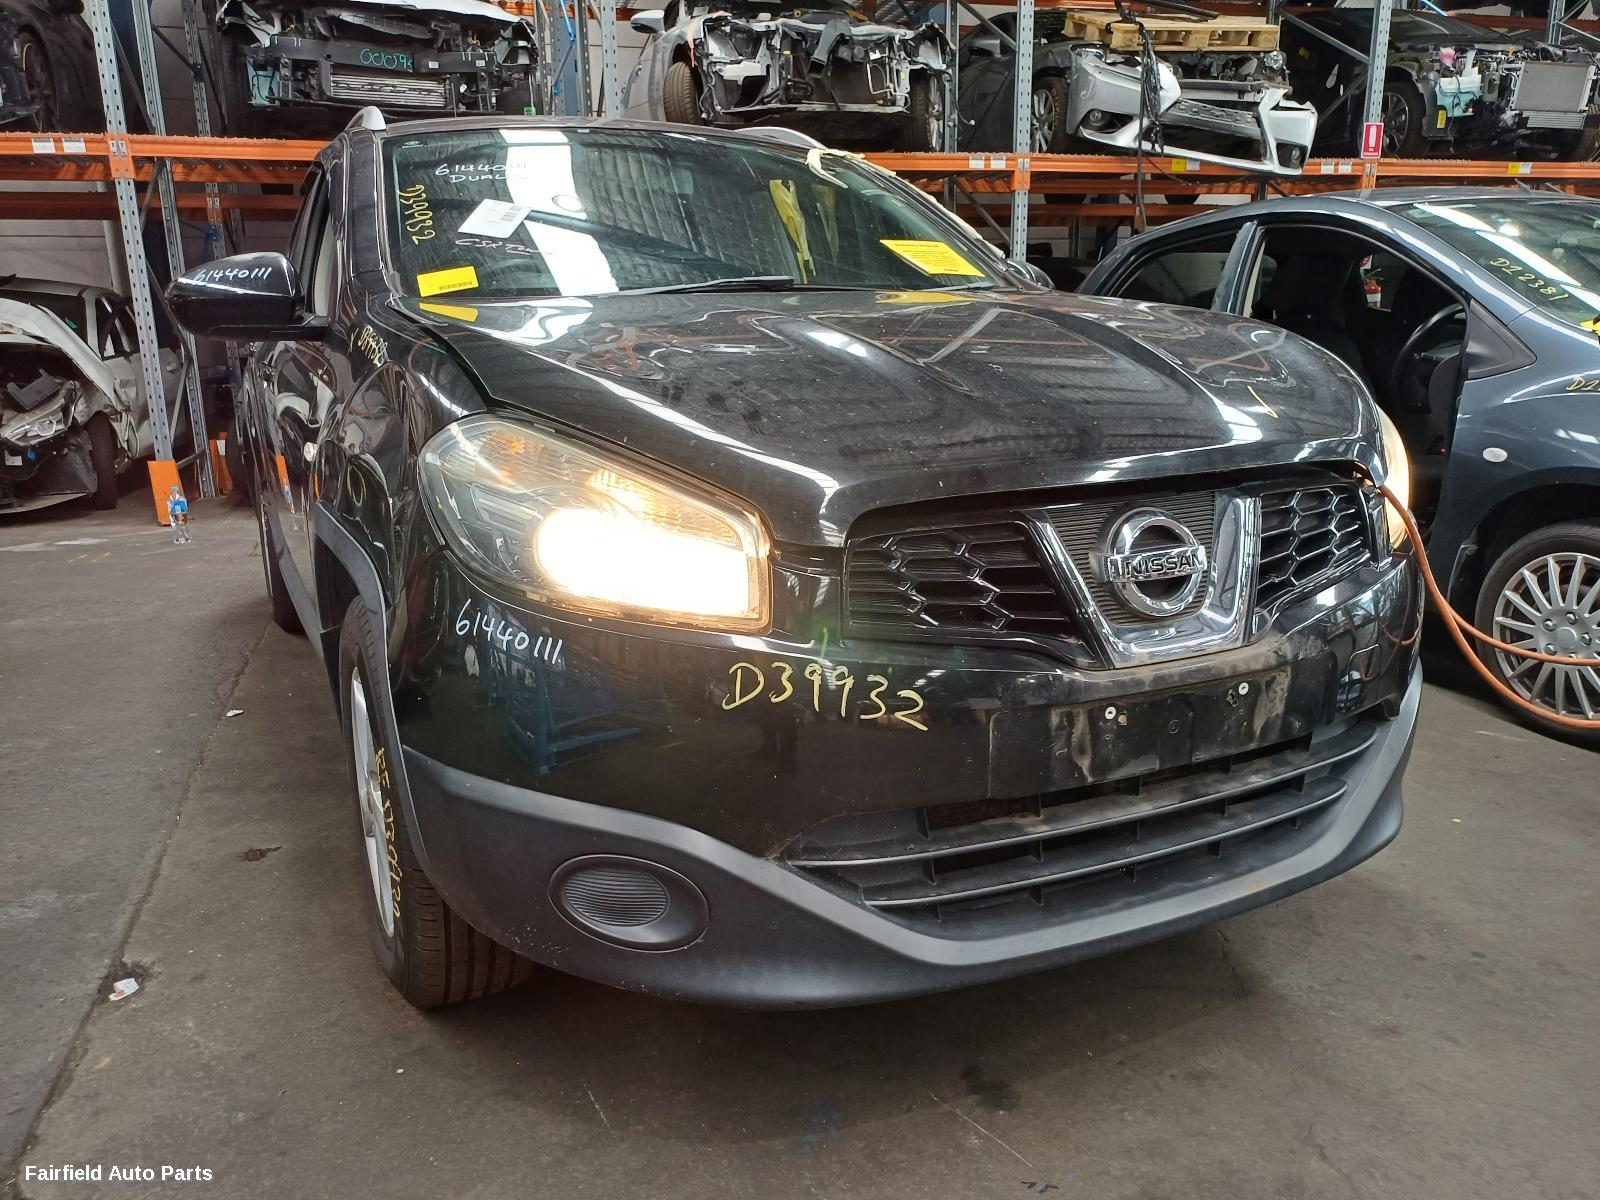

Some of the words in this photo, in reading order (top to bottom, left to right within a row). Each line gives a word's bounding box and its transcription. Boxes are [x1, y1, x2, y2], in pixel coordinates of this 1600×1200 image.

[398, 184, 436, 245] D39932
[193, 266, 273, 282] 61440111
[1123, 552, 1203, 580] NISSAN
[455, 598, 563, 665] 61440111
[721, 662, 929, 731] D39932
